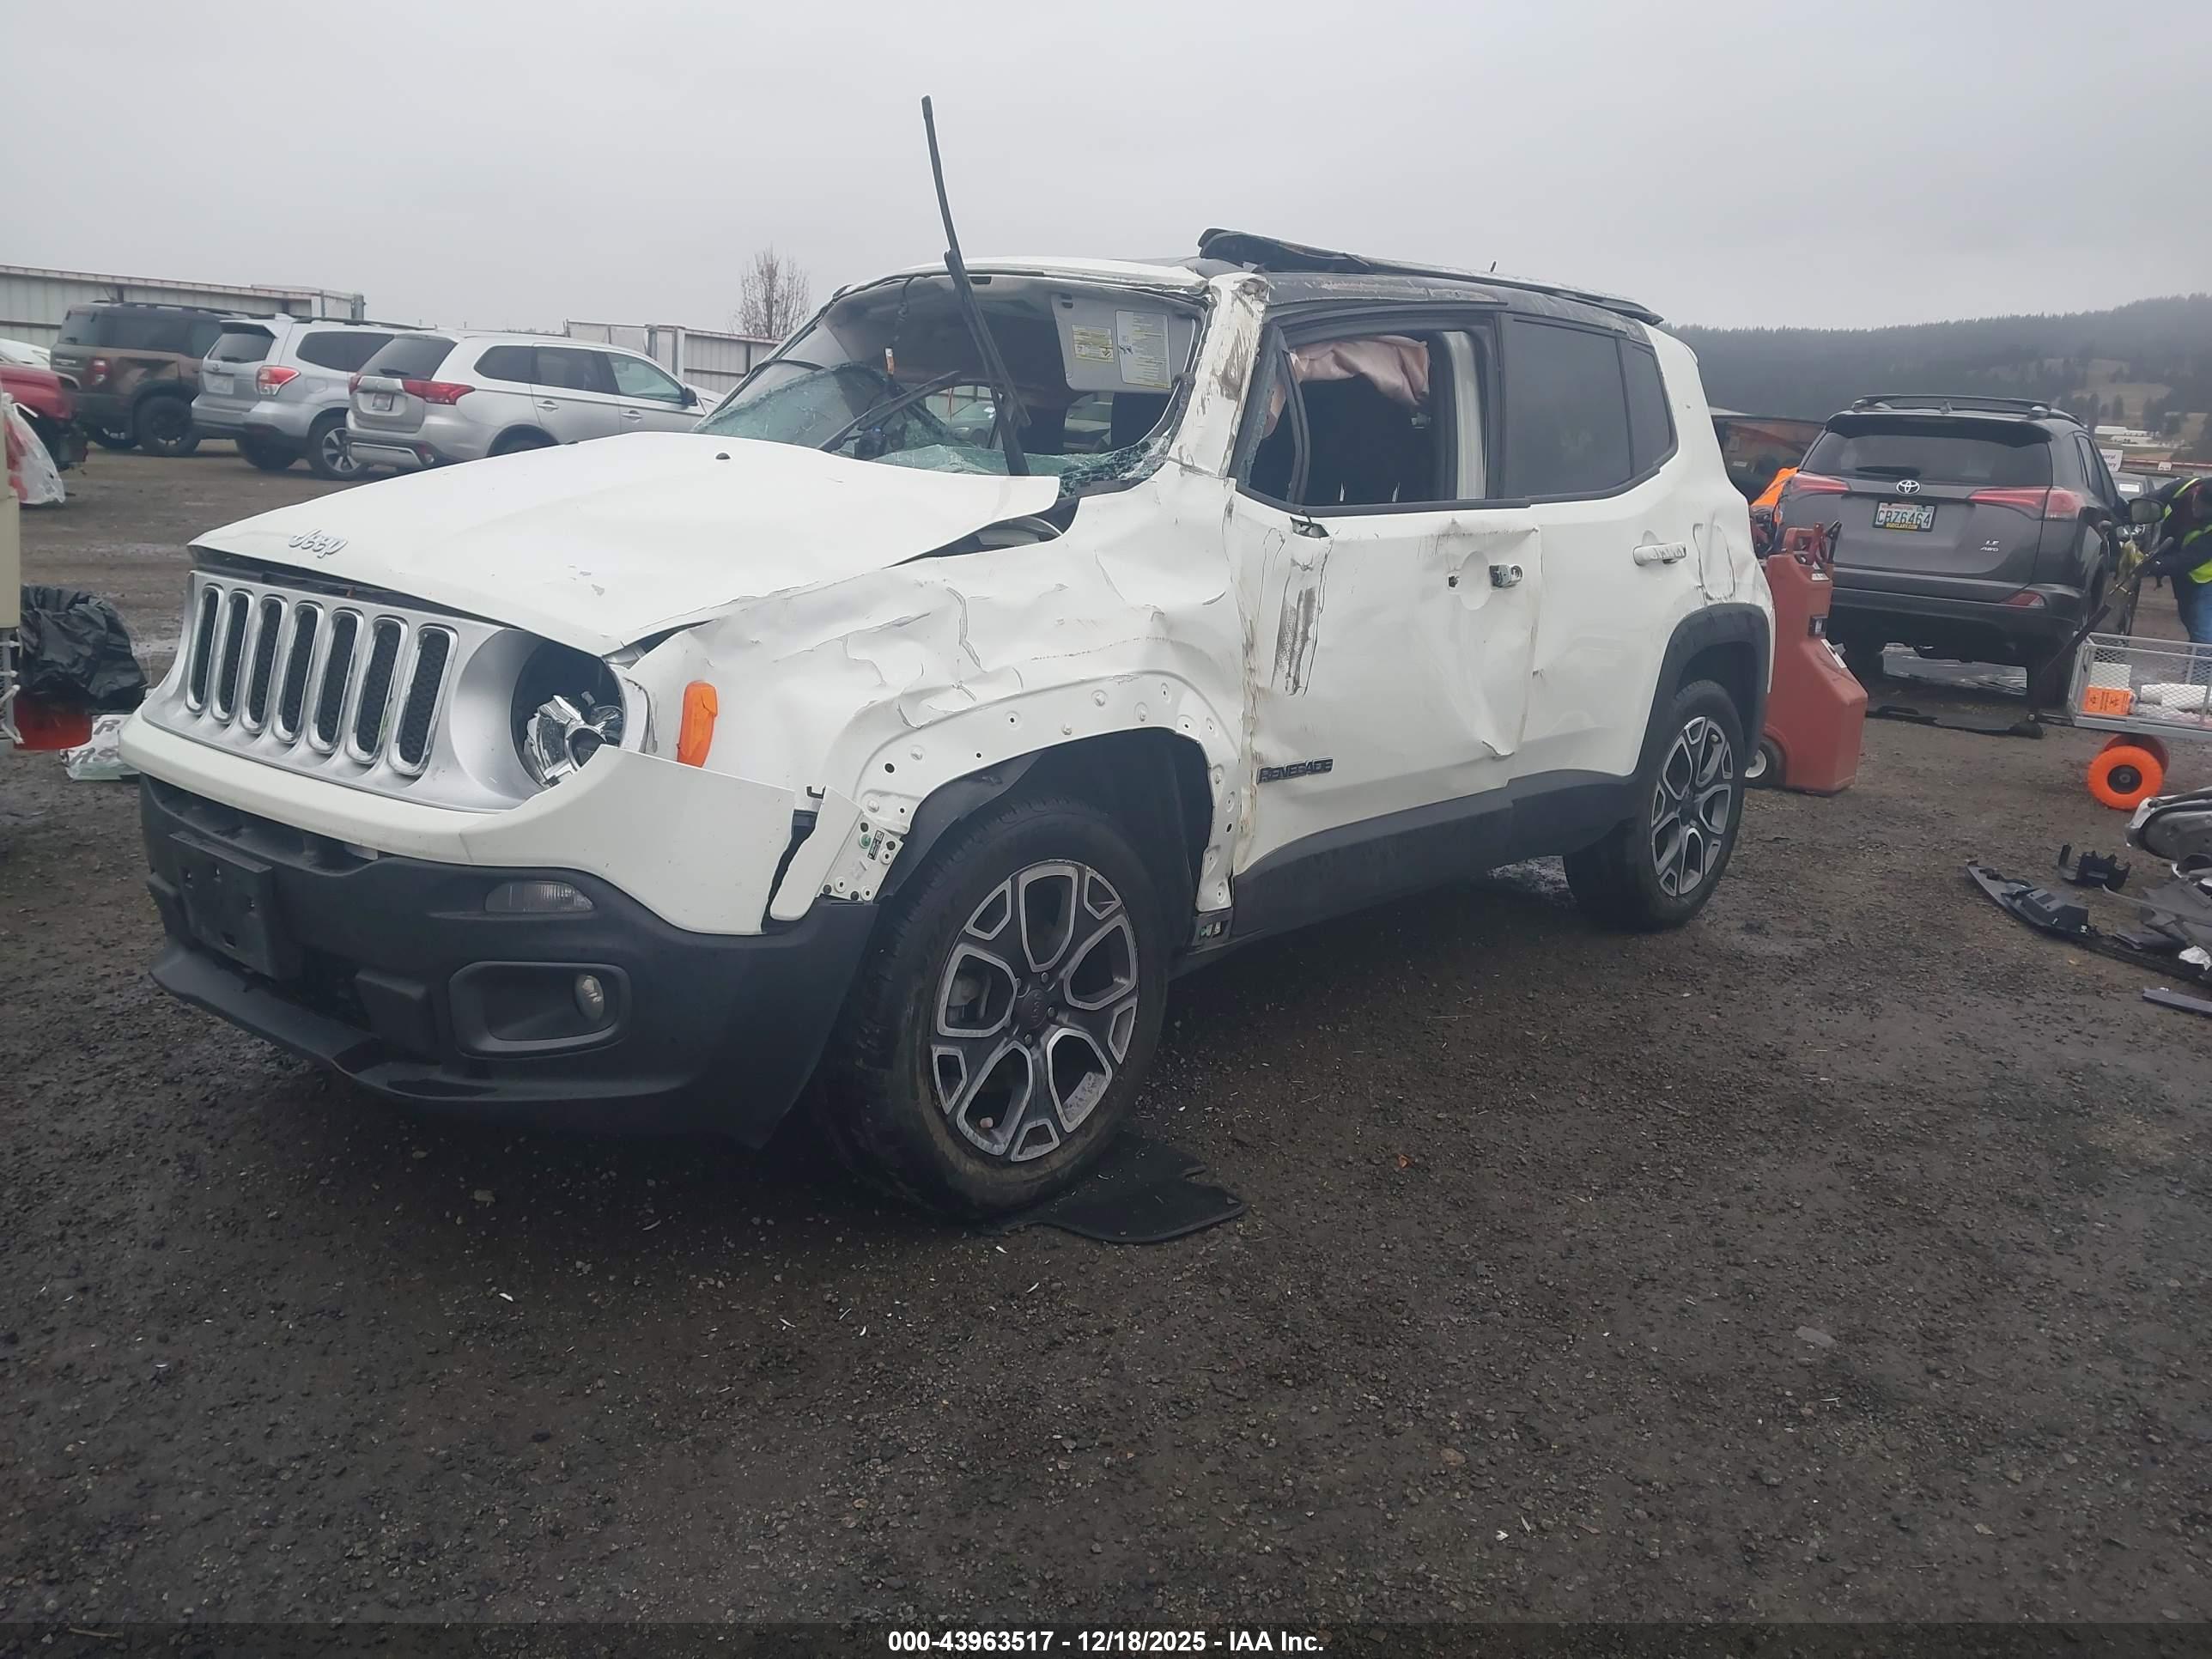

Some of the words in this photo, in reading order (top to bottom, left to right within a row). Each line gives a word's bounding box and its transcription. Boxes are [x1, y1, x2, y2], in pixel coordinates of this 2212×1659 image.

[1877, 510, 1931, 526] CBZ6464
[288, 527, 349, 559] Jeep
[1256, 757, 1334, 783] RENEGADE
